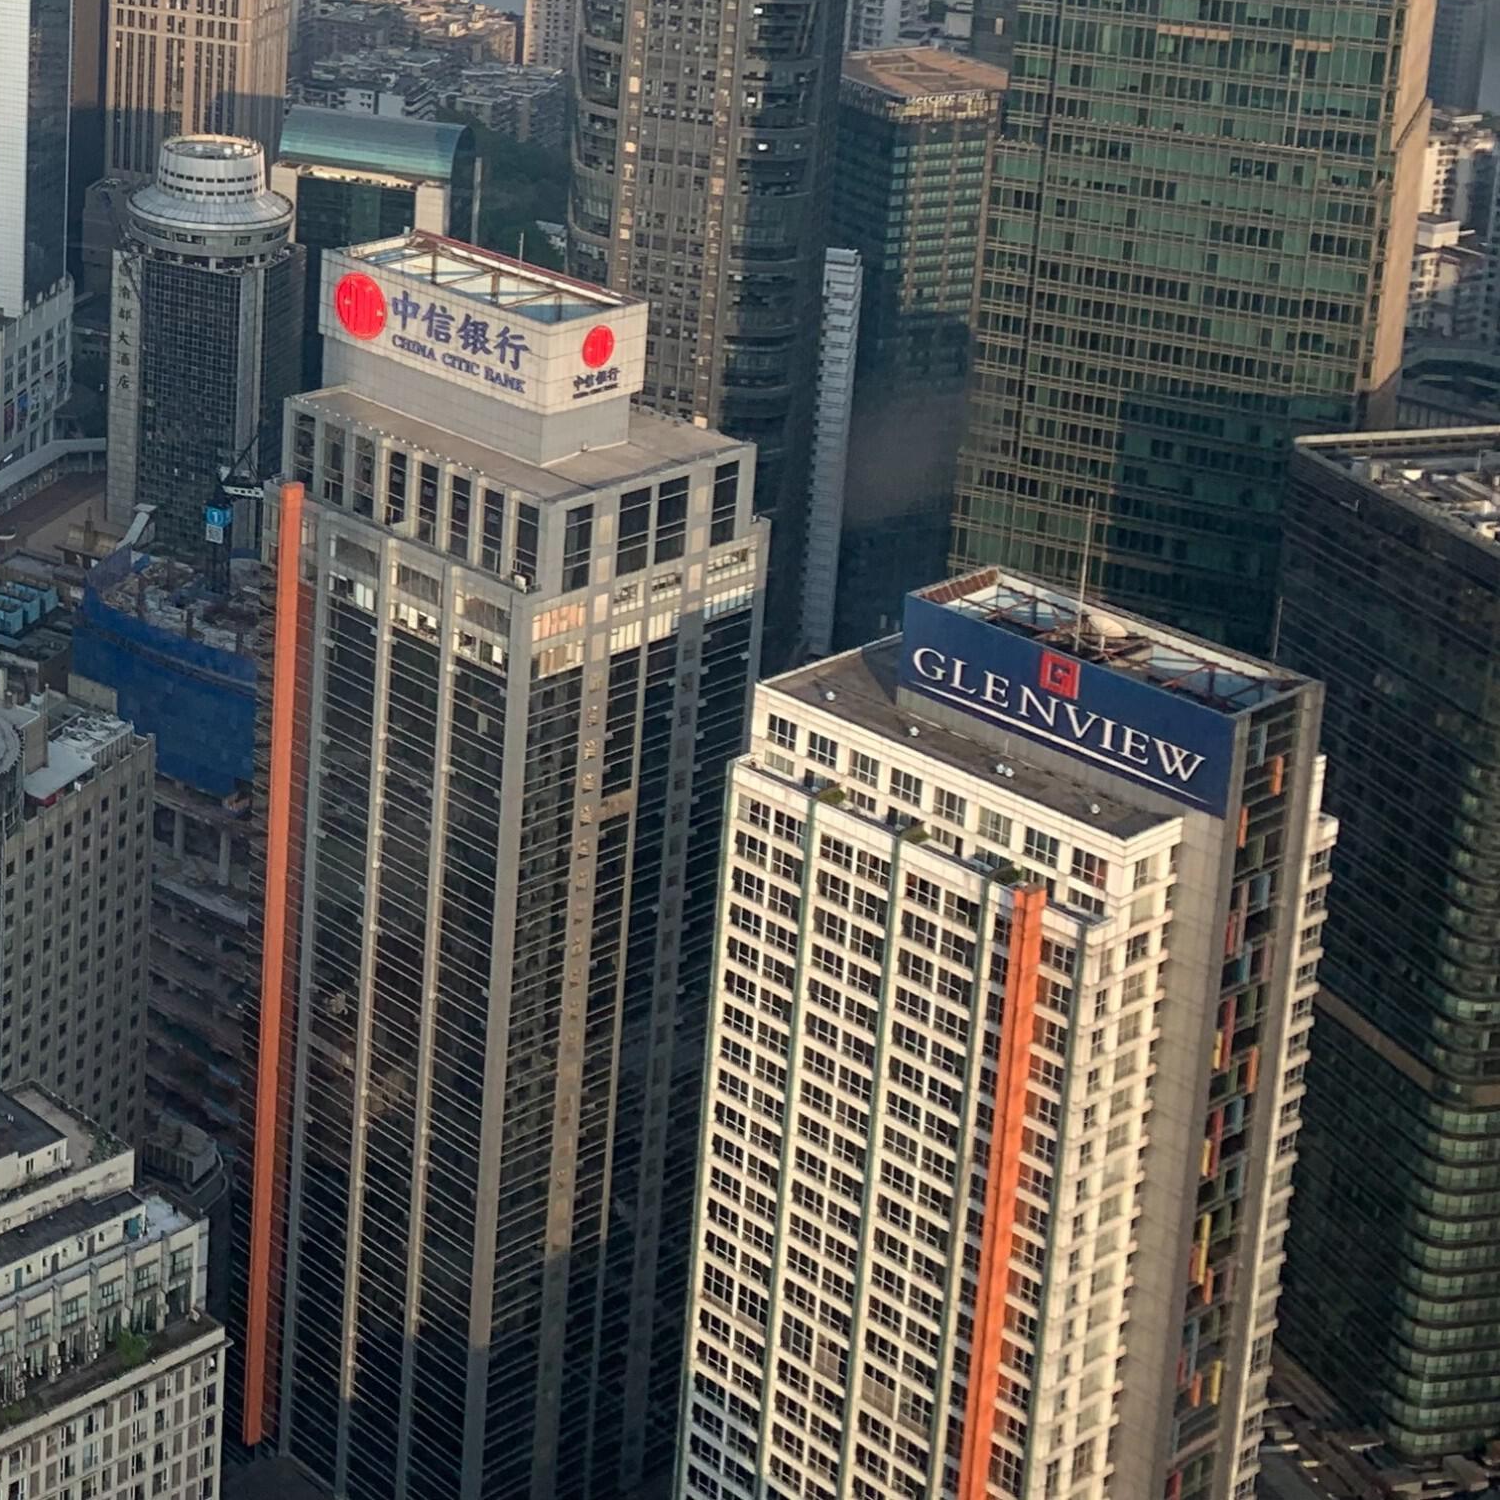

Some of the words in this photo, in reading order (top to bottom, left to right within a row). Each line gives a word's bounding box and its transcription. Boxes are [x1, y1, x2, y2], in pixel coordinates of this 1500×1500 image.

[392, 290, 529, 371] 中信银行
[392, 333, 437, 362] CHINA
[442, 352, 480, 376] CITIC
[484, 366, 526, 394] BANK
[912, 647, 1206, 782] GLENVIEW
